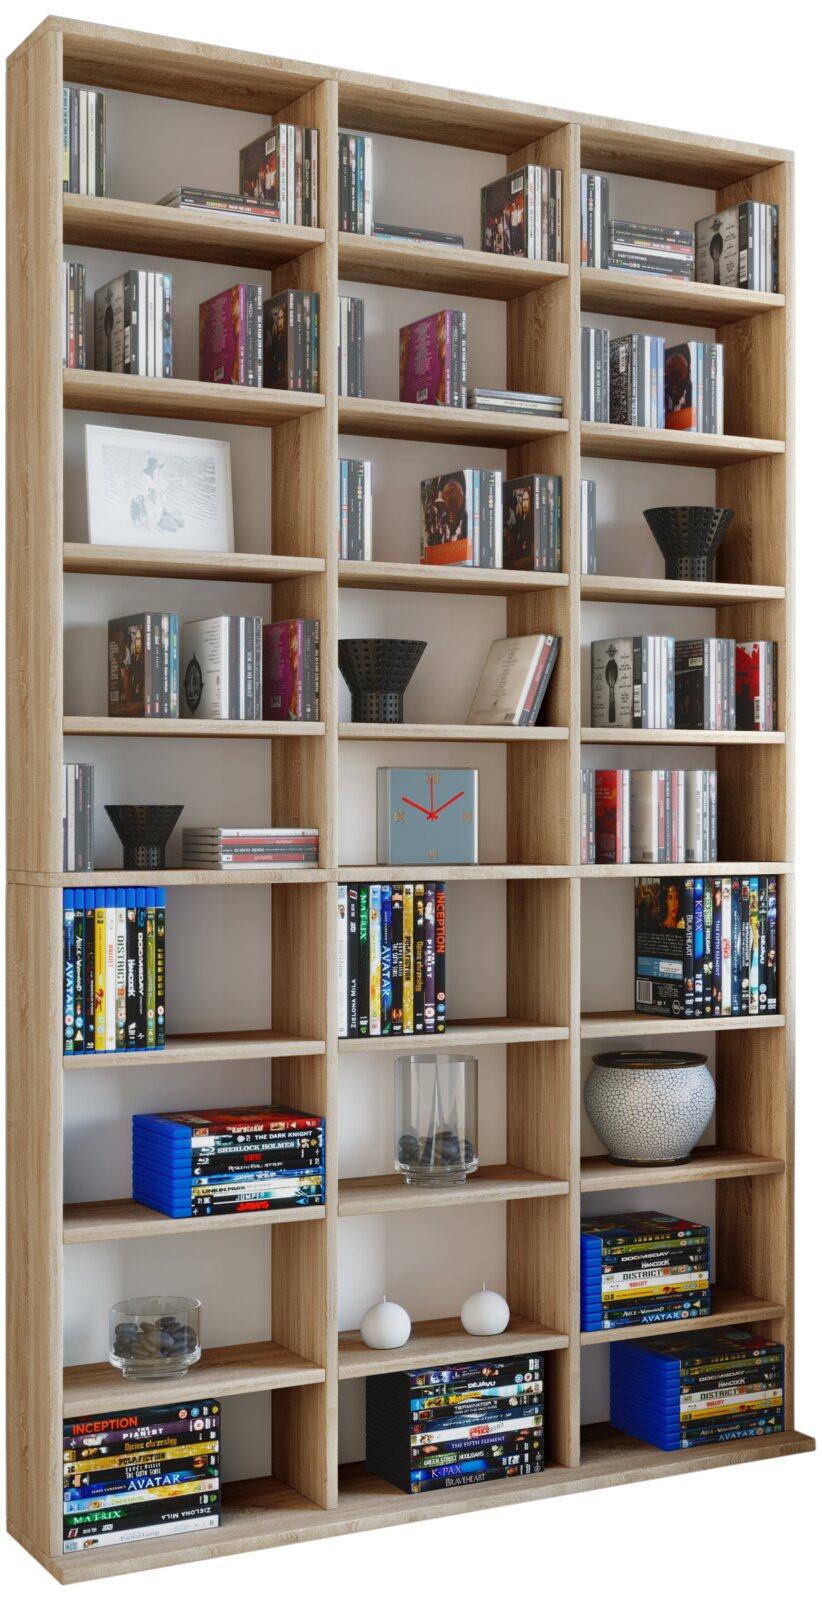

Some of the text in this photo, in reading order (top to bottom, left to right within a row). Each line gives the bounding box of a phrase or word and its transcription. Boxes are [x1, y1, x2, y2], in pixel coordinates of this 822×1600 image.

[436, 892, 445, 953] INCEPTION
[65, 962, 73, 1012] AVATAR
[217, 1145, 260, 1153] SHERLOCK
[202, 1185, 226, 1194] LINKIN
[236, 1192, 265, 1200] JUMPER
[236, 1201, 270, 1211] JAWS
[621, 1251, 669, 1262] DOOMSDAY
[642, 1259, 670, 1269] HANCOCK
[623, 1270, 661, 1280] DISTRICT
[642, 1313, 680, 1323] AVATAR
[699, 1371, 744, 1382] DOOMSDAY
[718, 1378, 745, 1387] HANCOCK
[701, 1388, 737, 1400] DISTRICT
[73, 1416, 138, 1435] INCEPTION
[122, 1428, 163, 1439] PIANIST
[719, 1430, 754, 1441] AVATAR
[481, 1436, 505, 1445] ELEMENT
[119, 1453, 166, 1465] PULP FICTION
[458, 1451, 484, 1460] HOOLIGANS
[432, 1465, 462, 1478] K-PAX
[128, 1474, 181, 1491] AVATAR
[446, 1474, 486, 1486] BRAVEHEART
[73, 1510, 121, 1524] MATRIX
[161, 1508, 211, 1520] ZIELONA MILA
